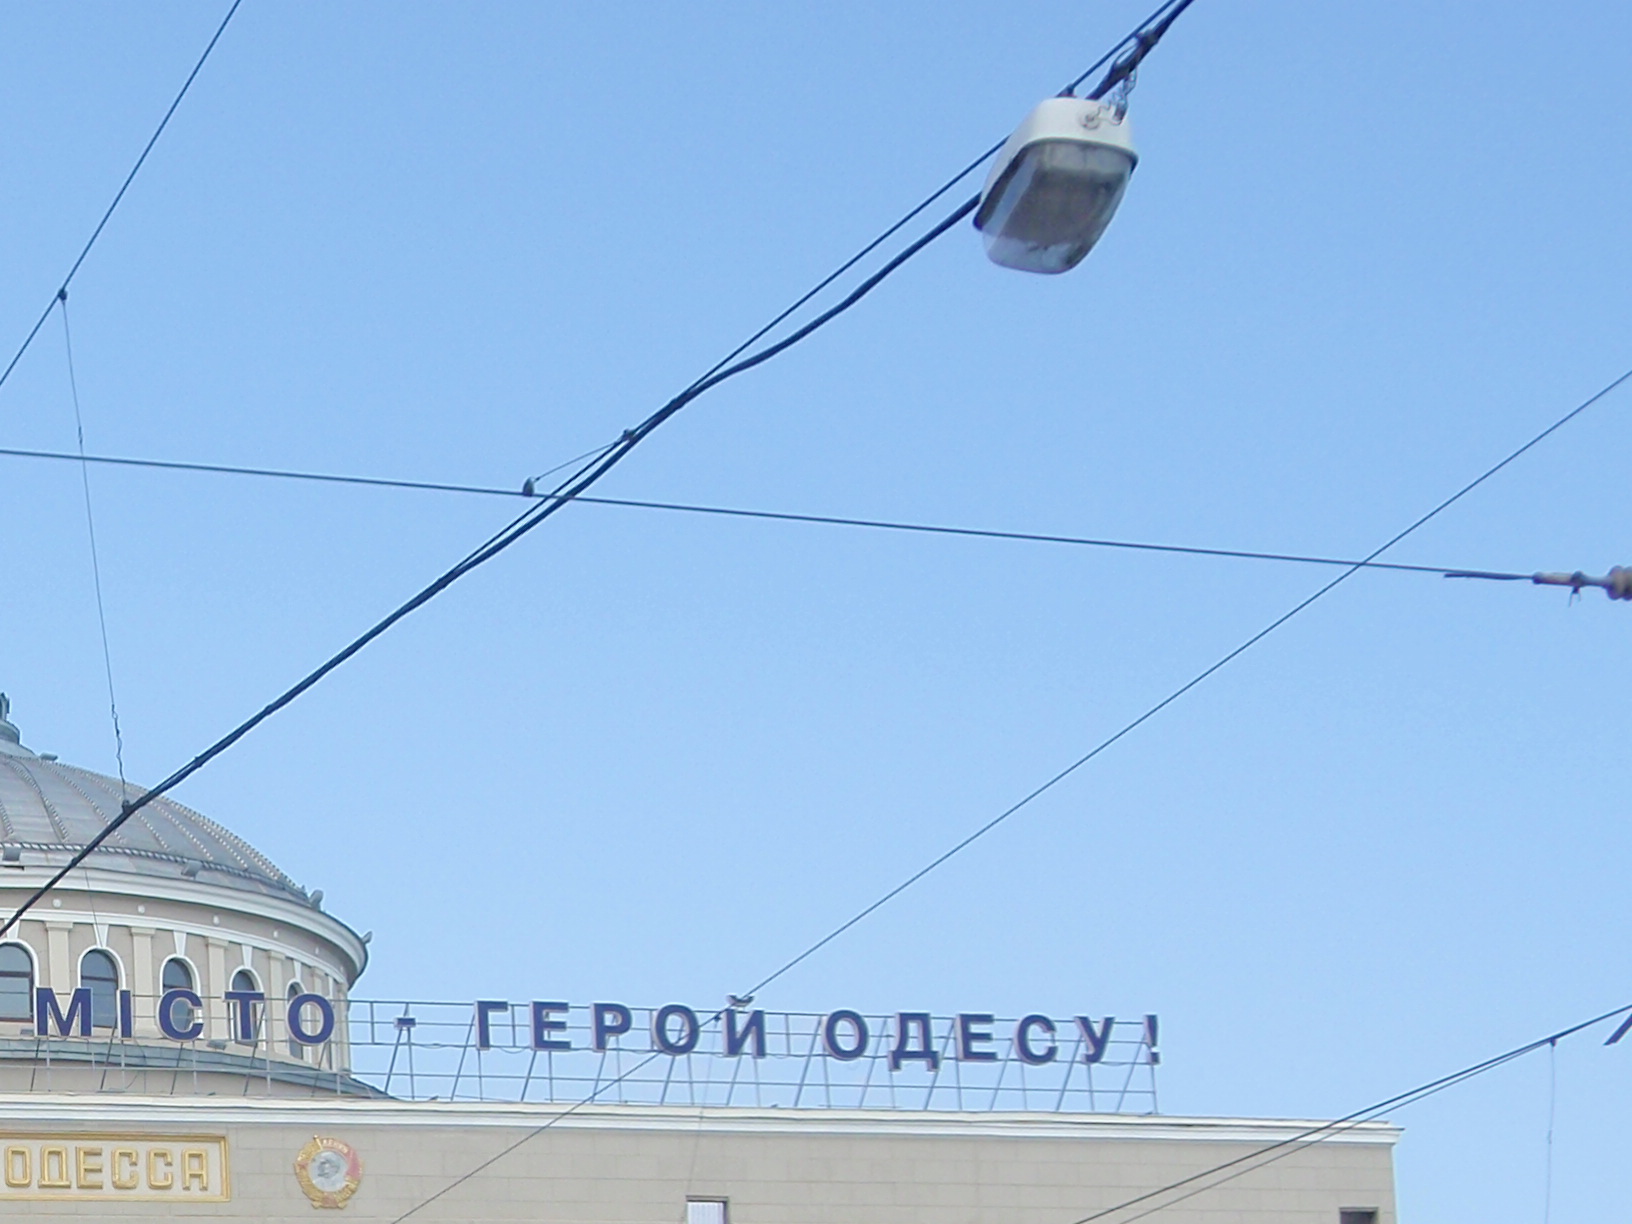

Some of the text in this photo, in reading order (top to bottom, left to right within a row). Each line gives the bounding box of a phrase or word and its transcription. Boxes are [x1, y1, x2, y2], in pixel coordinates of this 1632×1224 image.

[35, 986, 335, 1045] МІСТО
[475, 991, 767, 1058] ГЕРОЙ
[823, 1008, 1161, 1072] ОДЕСУ!
[5, 1145, 208, 1191] ОДЕССА
